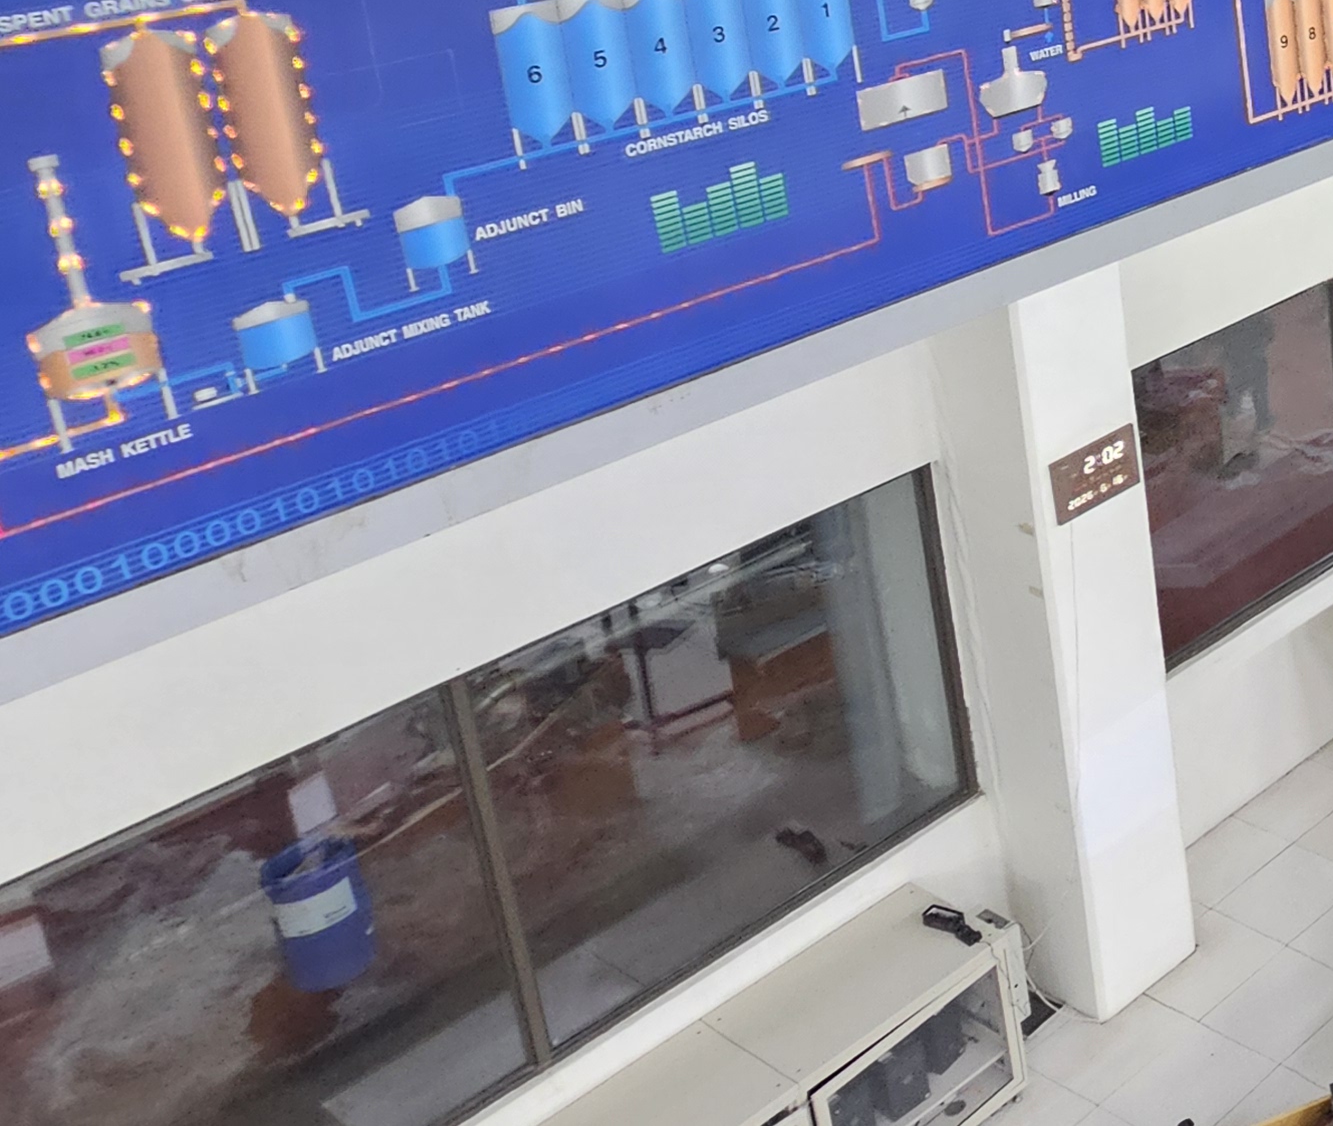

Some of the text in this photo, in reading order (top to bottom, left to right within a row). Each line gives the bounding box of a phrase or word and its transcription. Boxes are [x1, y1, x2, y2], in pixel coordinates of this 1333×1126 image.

[0, 5, 74, 33] SPENT
[526, 2, 831, 84] 6 5 4 3 2 1
[1029, 44, 1064, 62] WATER
[625, 110, 770, 158] CORNSTARCH SILOS
[1057, 186, 1097, 208] MILLING
[475, 199, 584, 241] ADJUNCT BIN
[332, 301, 491, 362] ADJUNCT MIXING TANK
[56, 423, 194, 479] MASH KETTLE
